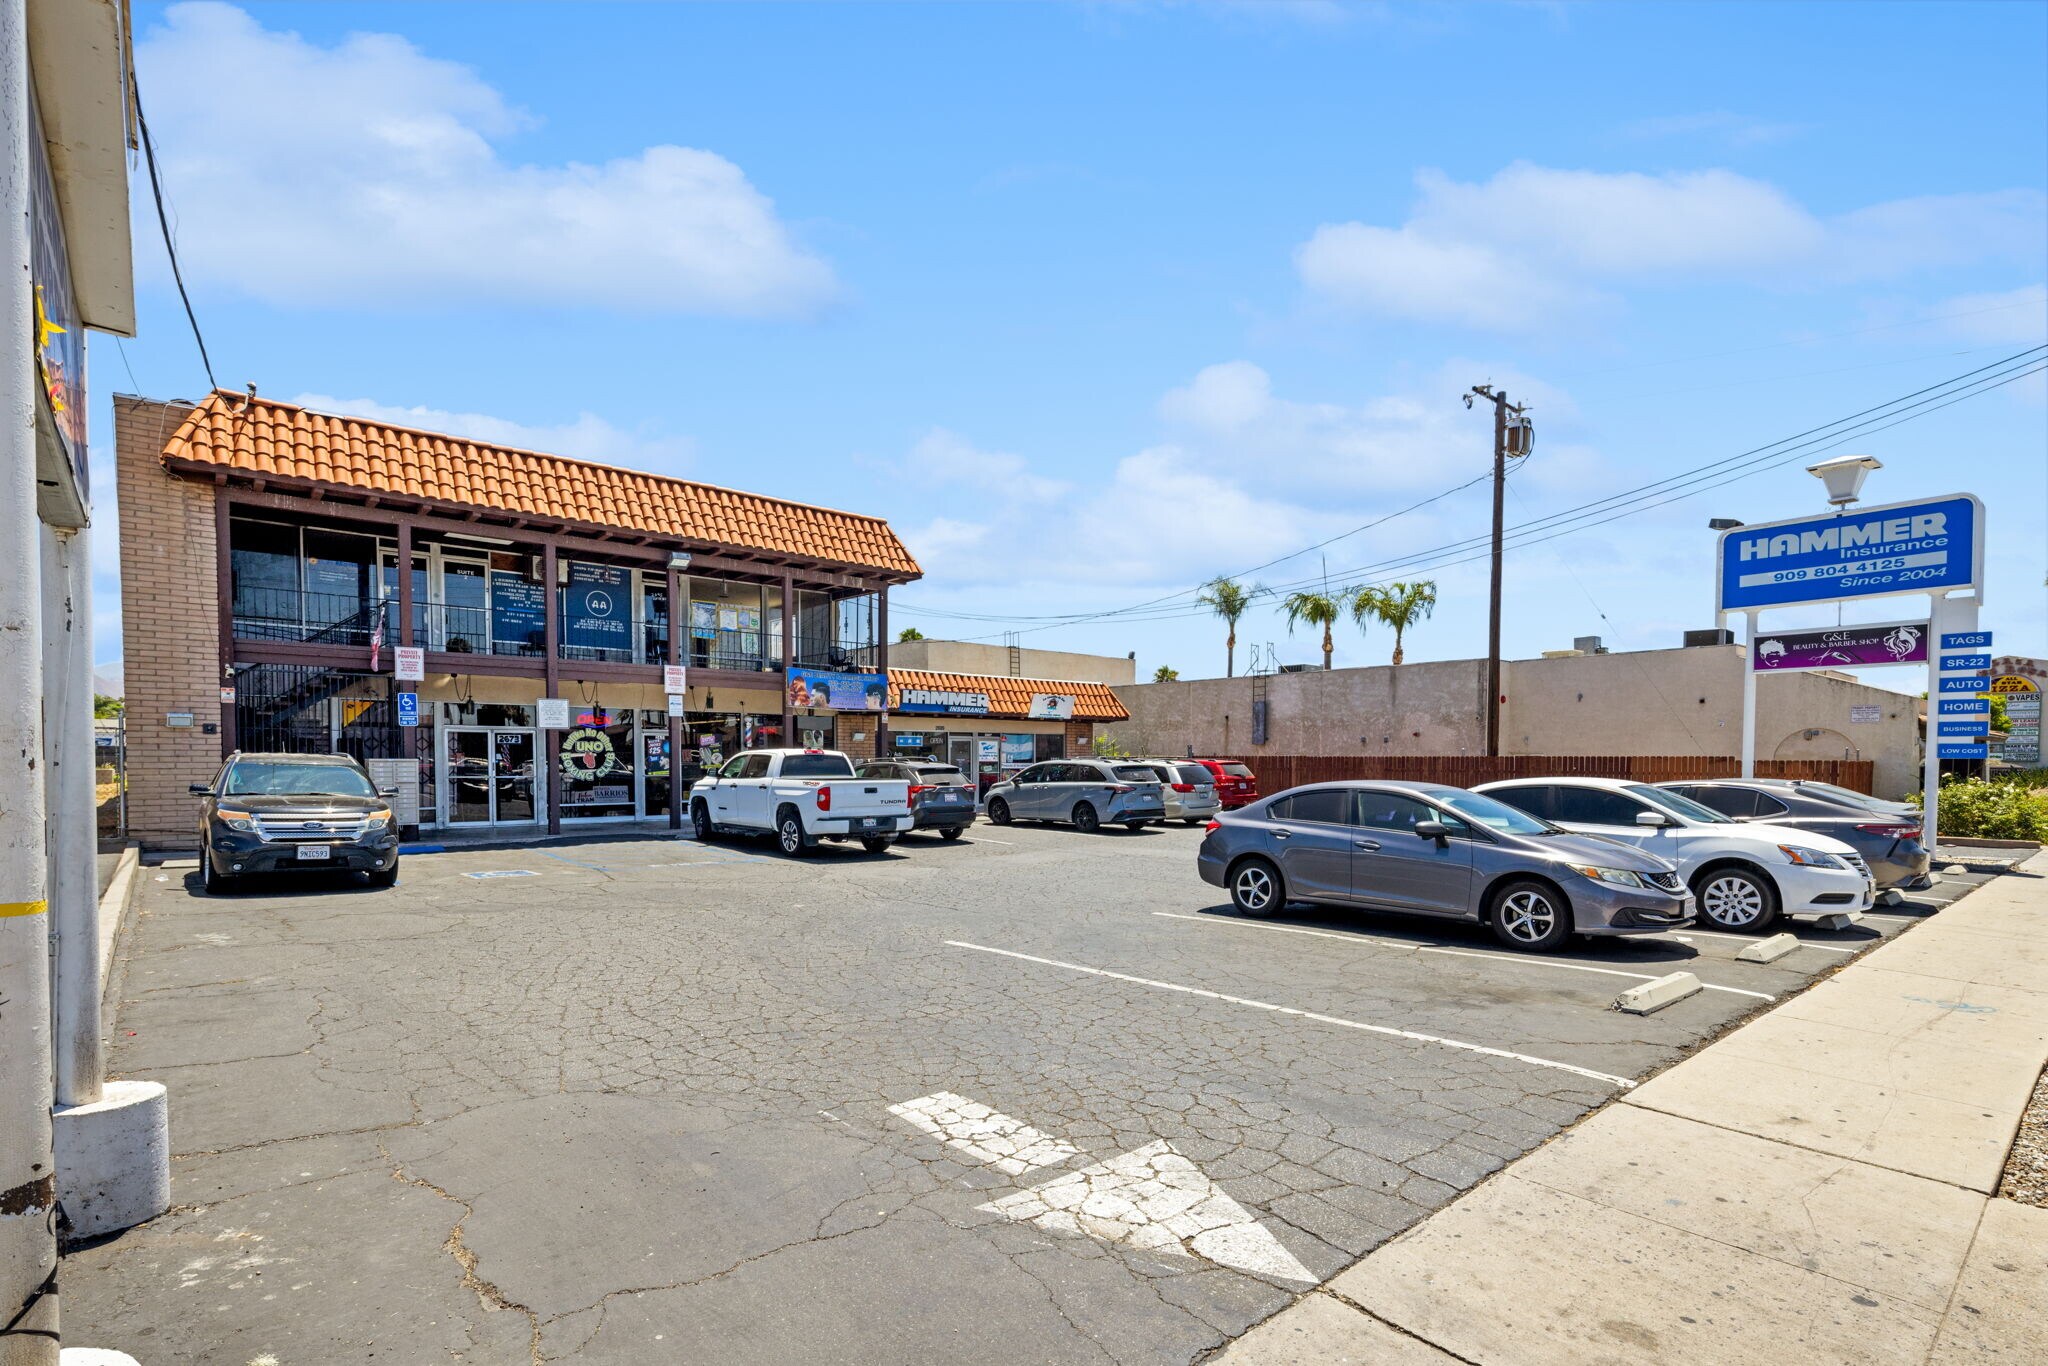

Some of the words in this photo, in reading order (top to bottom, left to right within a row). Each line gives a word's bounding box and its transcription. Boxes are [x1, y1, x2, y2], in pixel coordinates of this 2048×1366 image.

[1740, 512, 1948, 562] HAMMER
[1840, 536, 1949, 559] Insurance
[1773, 570, 1807, 582] 909
[1814, 564, 1848, 577] 804
[1856, 557, 1906, 572] 4125
[1839, 575, 1893, 588] Since
[1898, 567, 1947, 581] 2004
[1822, 631, 1851, 642] G&E
[1948, 635, 1985, 645] TAGS
[1946, 658, 1985, 667] SR-22
[1946, 680, 1984, 689] AUTO
[902, 689, 989, 708] HAMMER
[949, 706, 988, 714] INSURANCE
[1943, 702, 1984, 711] HOME
[577, 714, 613, 725] OPEN
[499, 735, 520, 743] 2673
[575, 741, 604, 752] UNO
[561, 752, 595, 781] BOXING
[595, 752, 616, 778] CLUB
